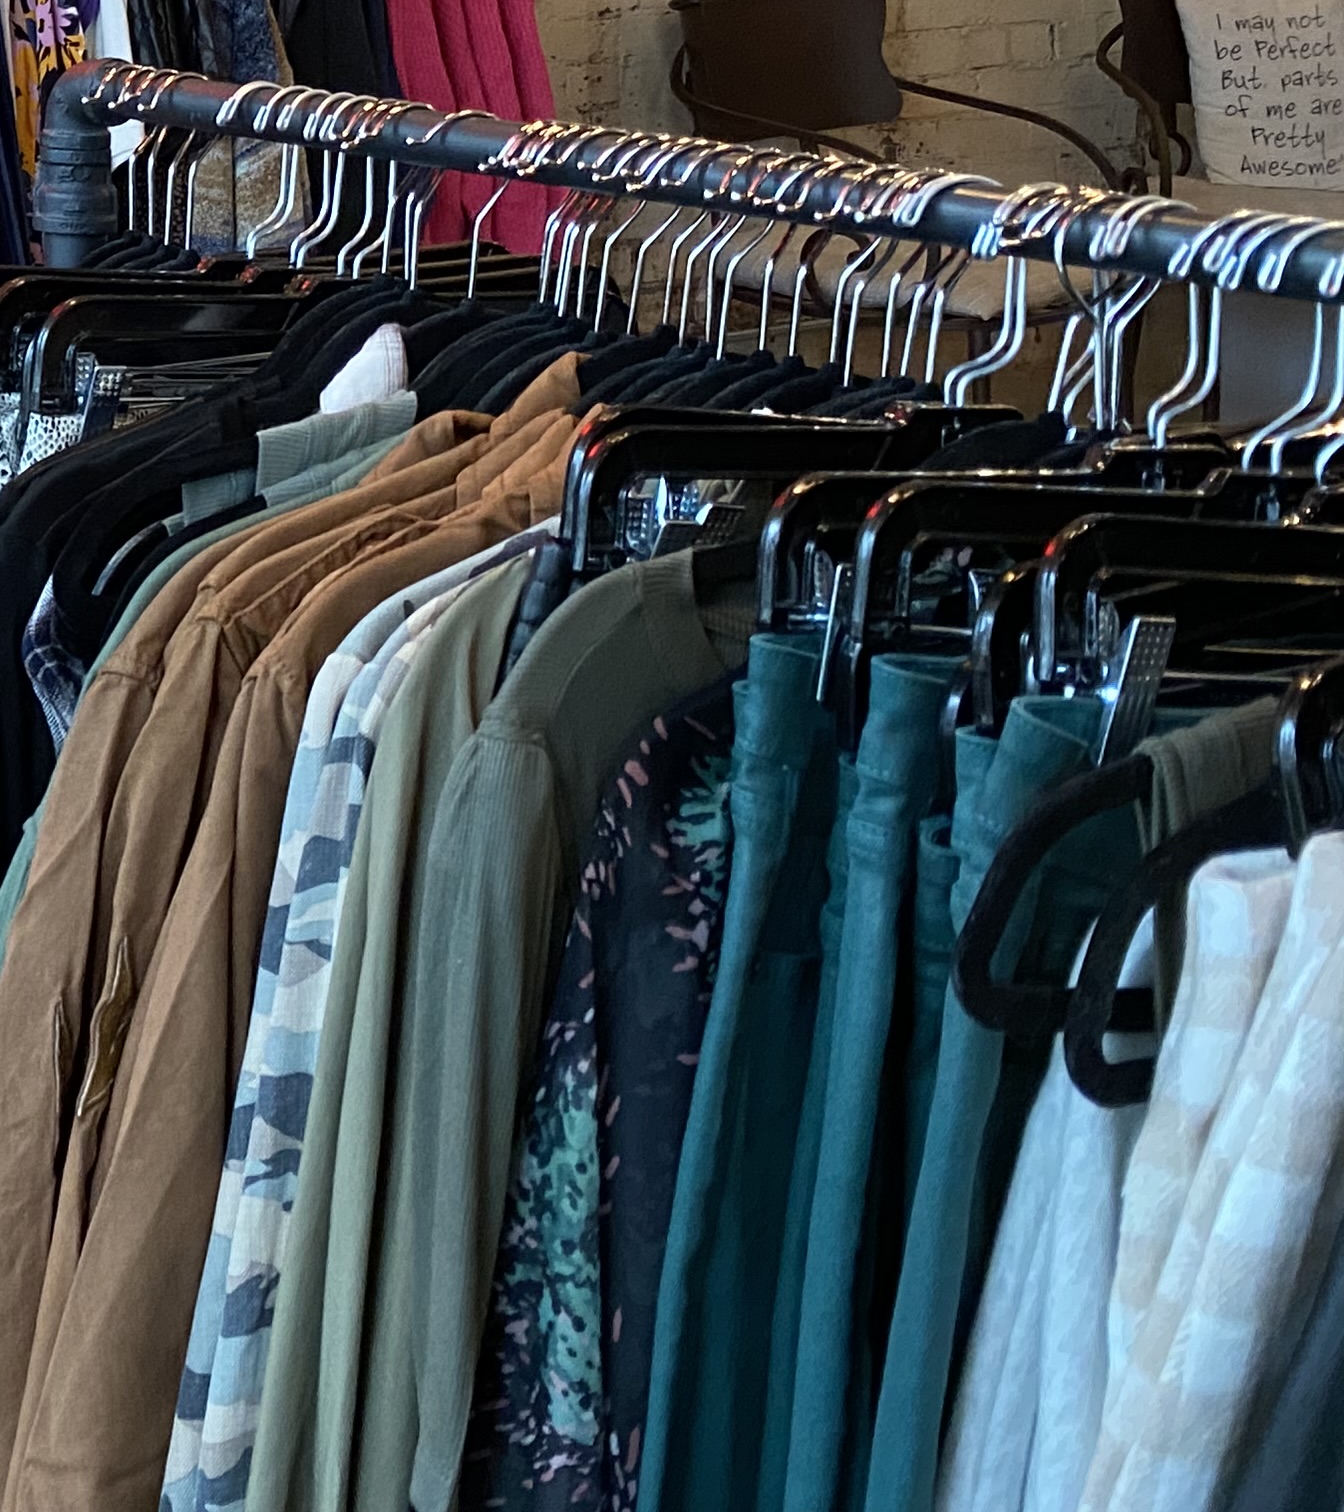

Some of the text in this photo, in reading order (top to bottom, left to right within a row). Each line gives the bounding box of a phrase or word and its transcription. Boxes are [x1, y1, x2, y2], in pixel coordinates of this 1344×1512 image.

[1215, 3, 1326, 42] I may not
[1214, 31, 1337, 62] be Perfect
[1280, 62, 1339, 93] parts
[1224, 94, 1343, 120] of me are
[1250, 122, 1327, 161] Pretty
